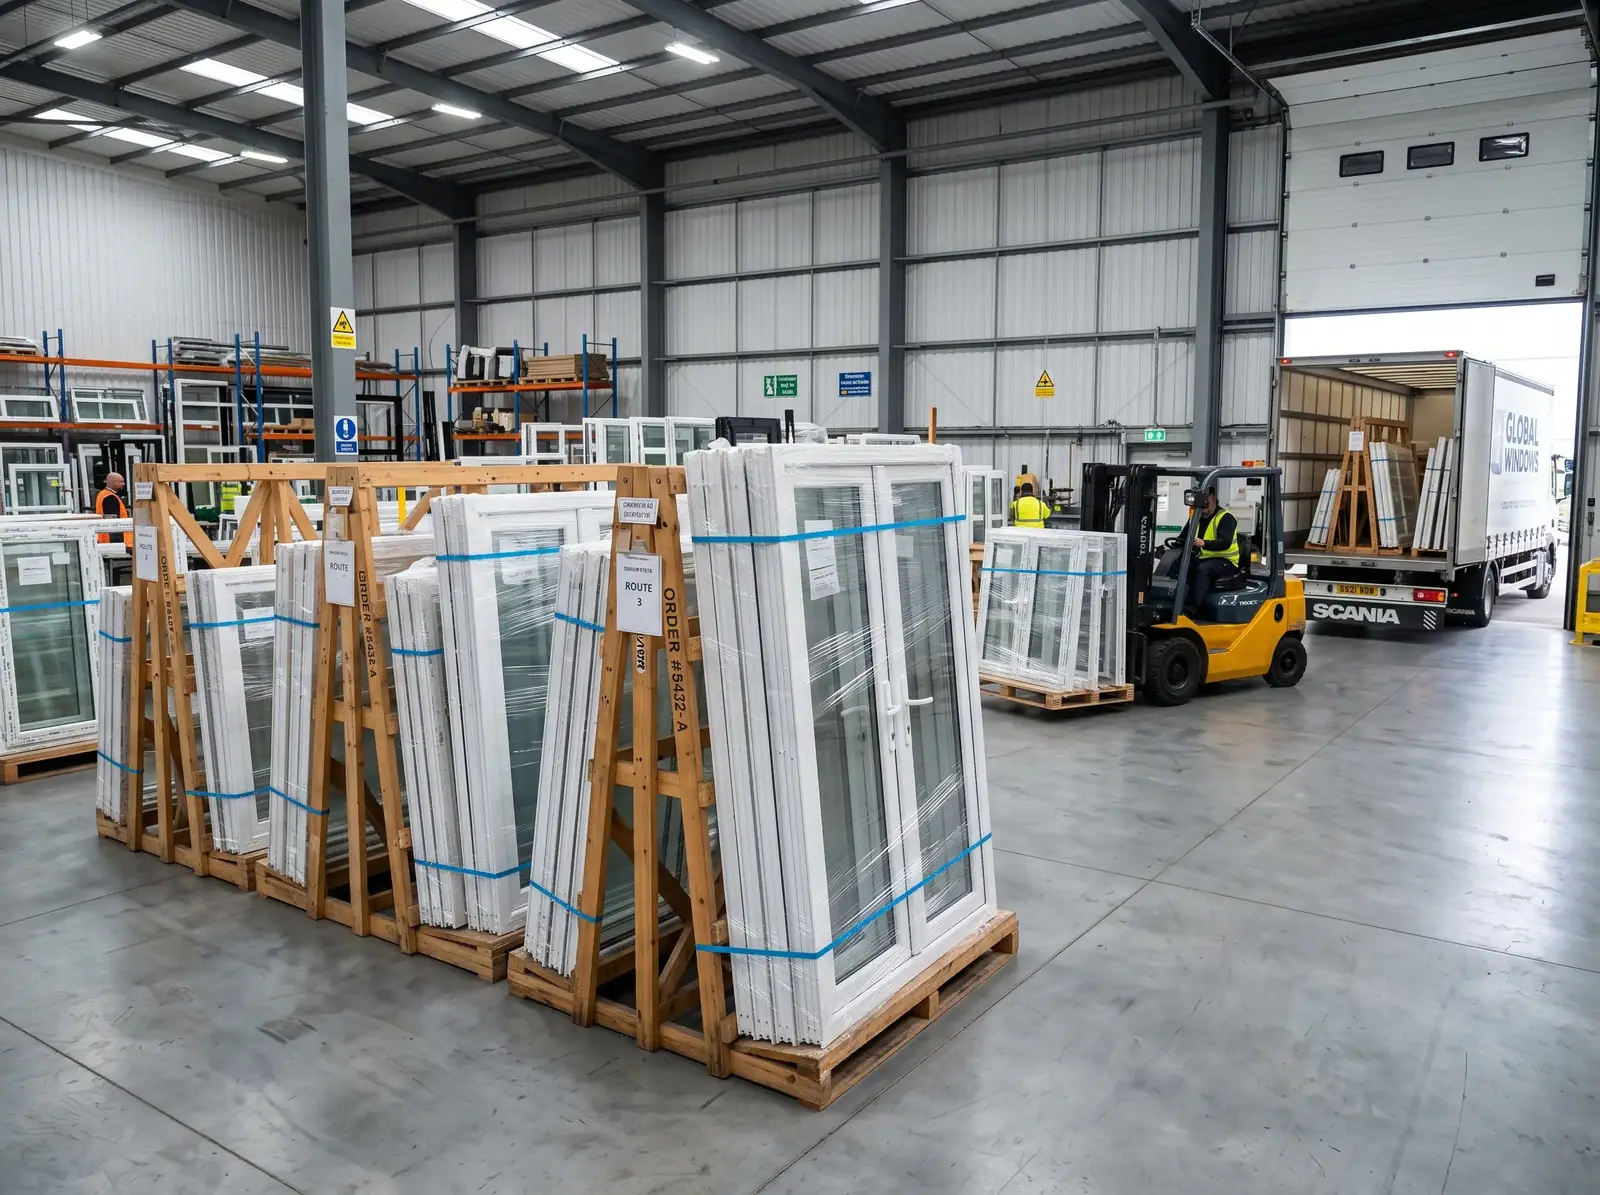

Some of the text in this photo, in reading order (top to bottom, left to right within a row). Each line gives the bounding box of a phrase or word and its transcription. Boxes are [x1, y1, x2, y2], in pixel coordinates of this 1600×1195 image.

[1506, 411, 1538, 446] GLOBAL
[1504, 447, 1539, 473] WINDOWS
[330, 562, 349, 571] ROUTE
[625, 581, 653, 593] ROUTE
[637, 597, 642, 607] 3
[1312, 602, 1400, 625] SCANIA
[664, 587, 680, 653] ORDER
